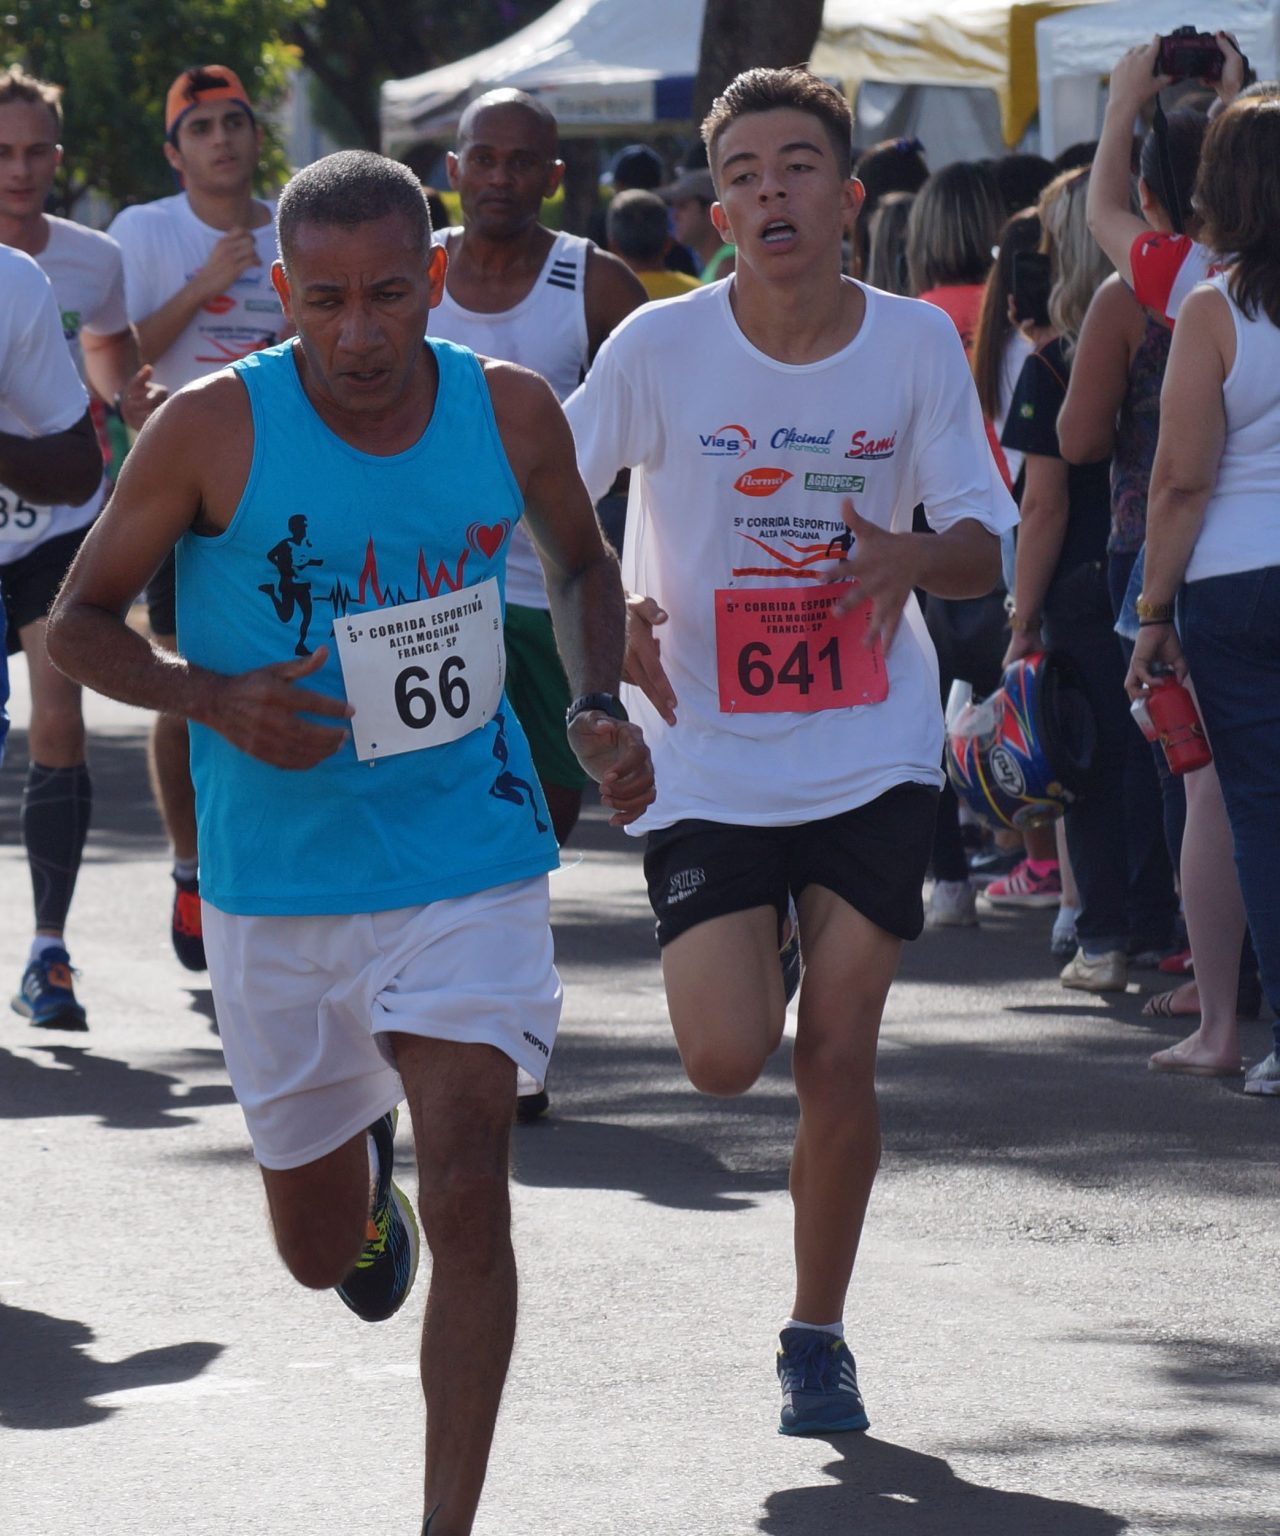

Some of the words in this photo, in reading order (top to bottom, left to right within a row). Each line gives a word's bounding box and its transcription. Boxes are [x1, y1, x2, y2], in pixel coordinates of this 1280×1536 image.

[847, 430, 898, 457] Sami
[807, 473, 854, 488] AGROPEC
[746, 516, 791, 528] CORRIDA
[793, 517, 846, 532] ESPORTIVA
[759, 530, 778, 538] ALTA
[780, 529, 820, 540] MOGIANA
[744, 601, 796, 612] CORRIDA
[801, 597, 839, 611] ESPORT
[370, 617, 427, 640] CORRIDA
[431, 600, 483, 625] ESPORTIVA
[760, 614, 783, 623] ALTA
[785, 611, 827, 623] MOGIANA
[389, 635, 414, 649] ALTA
[417, 622, 460, 643] MOGIANA
[767, 625, 805, 634] FRANCA
[398, 641, 440, 660] FRANCA
[737, 636, 843, 696] 641
[394, 655, 472, 730] 66
